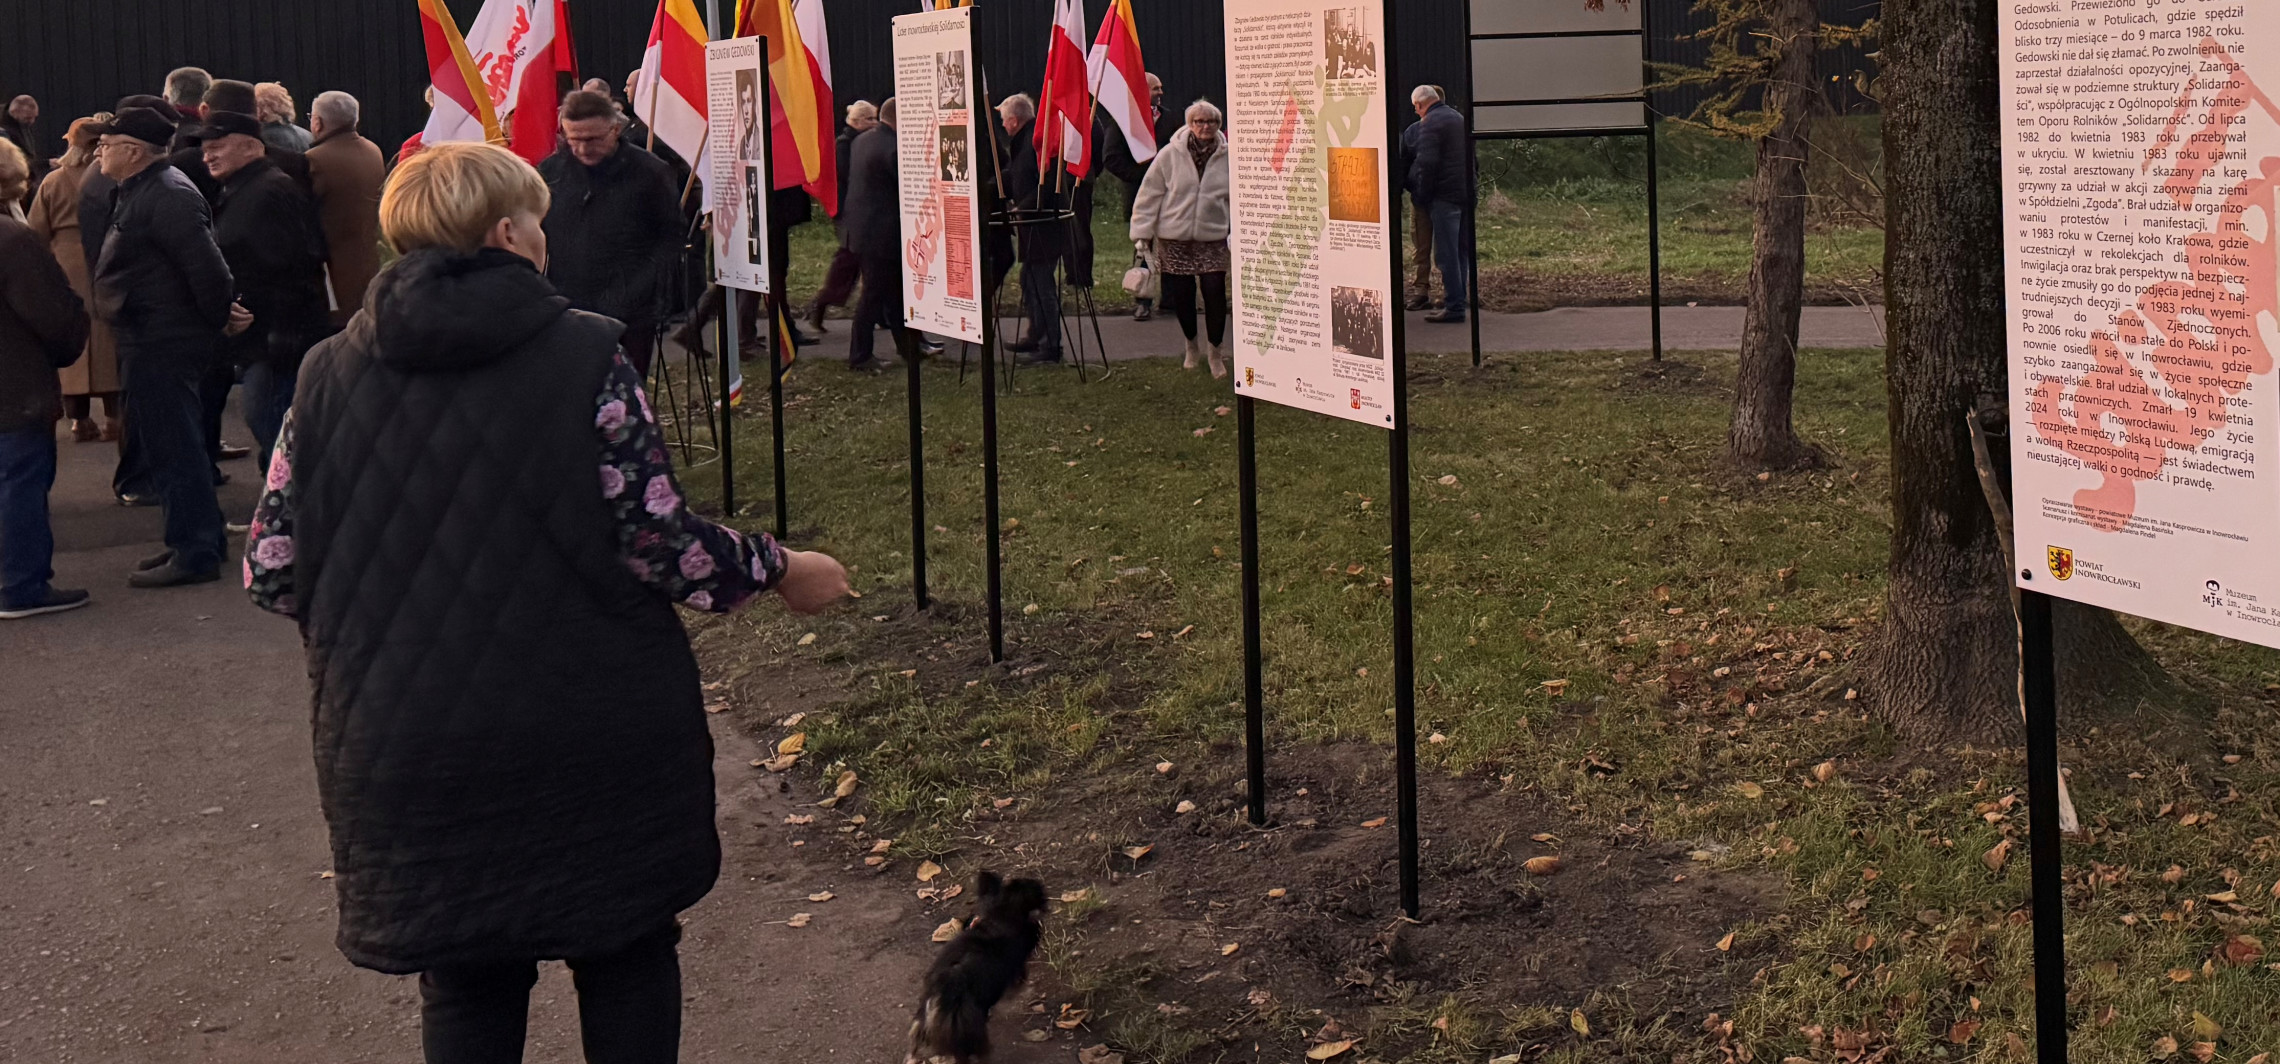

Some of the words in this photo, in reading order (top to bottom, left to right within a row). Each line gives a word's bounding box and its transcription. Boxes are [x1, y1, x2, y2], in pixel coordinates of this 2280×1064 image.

[2015, 17, 2079, 31] Odosobnienia
[2167, 9, 2196, 24] gdzie
[2205, 6, 2243, 22] spędził
[2015, 36, 2041, 46] blisko
[2045, 36, 2062, 47] trzy
[2067, 32, 2107, 45] miesiące
[2122, 30, 2135, 41] do
[2139, 29, 2145, 40] 9
[2150, 30, 2181, 39] marca
[2186, 26, 2212, 37] 1982
[2016, 67, 2061, 81] zaprzestał
[2067, 64, 2123, 76] działalności
[2016, 84, 2042, 94] żował
[2046, 83, 2058, 96] się
[2075, 82, 2129, 96] podziemne
[2133, 80, 2179, 94] struktury
[2038, 99, 2105, 112] współpracując
[2118, 96, 2197, 111] Ogólnopolskim
[2017, 118, 2034, 126] tem
[2039, 116, 2068, 128] Oporu
[2074, 115, 2118, 125] Rolników
[2199, 113, 2214, 125] Od
[2221, 113, 2246, 127] lipca
[2018, 132, 2039, 142] 1982
[2049, 132, 2061, 142] do
[2071, 131, 2110, 142] kwietnia
[2122, 132, 2145, 142] 1983
[2157, 130, 2179, 142] roku
[2191, 131, 2246, 145] przebywał
[2039, 164, 2066, 174] został
[2074, 166, 2135, 179] aresztowany
[2142, 165, 2147, 176] i
[2153, 165, 2194, 179] skazany
[2202, 169, 2215, 177] na
[2224, 166, 2247, 180] karę
[2019, 183, 2056, 193] grzywny
[2061, 183, 2071, 191] za
[2077, 181, 2106, 192] udział
[2125, 182, 2147, 196] akcji
[2153, 184, 2212, 196] zaorywania
[2218, 184, 2247, 195] ziemi
[2019, 212, 2046, 222] waniu
[2061, 214, 2109, 226] protestów
[2125, 215, 2127, 226] i
[2032, 228, 2053, 239] 1983
[2059, 229, 2079, 240] roku
[2097, 231, 2133, 246] Czernej
[2139, 232, 2161, 244] koło
[2219, 237, 2248, 251] gdzie
[2020, 245, 2075, 259] uczestniczył
[2101, 248, 2163, 263] rekolekcjach
[2173, 251, 2189, 263] dla
[2022, 309, 2053, 319] grował
[2074, 311, 2086, 322] do
[2108, 314, 2144, 327] Stanów
[2024, 355, 2055, 367] szybko
[2061, 361, 2123, 375] zaangażował
[2130, 366, 2143, 380] się
[2150, 371, 2158, 379] w
[2165, 370, 2191, 384] życie
[2198, 376, 2252, 390] społeczne
[2025, 369, 2027, 379] i
[2097, 379, 2115, 391] Brał
[2119, 382, 2148, 395] udział
[2152, 388, 2161, 396] w
[2165, 386, 2214, 405] lokalnych
[2027, 435, 2031, 443] a
[2035, 436, 2063, 450] wolną
[2067, 439, 2139, 463] Rzeczpospolitą
[2160, 454, 2178, 467] jest
[2183, 457, 2254, 479] świadectwem
[2027, 451, 2080, 470] nieustającej
[2083, 460, 2107, 472] walki
[2111, 465, 2117, 473] o
[2120, 466, 2163, 481] godność
[2167, 472, 2169, 482] i
[2075, 559, 2103, 572] POWIAT
[2075, 568, 2141, 590] INOWROCŁAWSKI
[2225, 588, 2257, 602] Muzeum
[2227, 598, 2241, 608] im.
[2246, 603, 2267, 614] Jana
